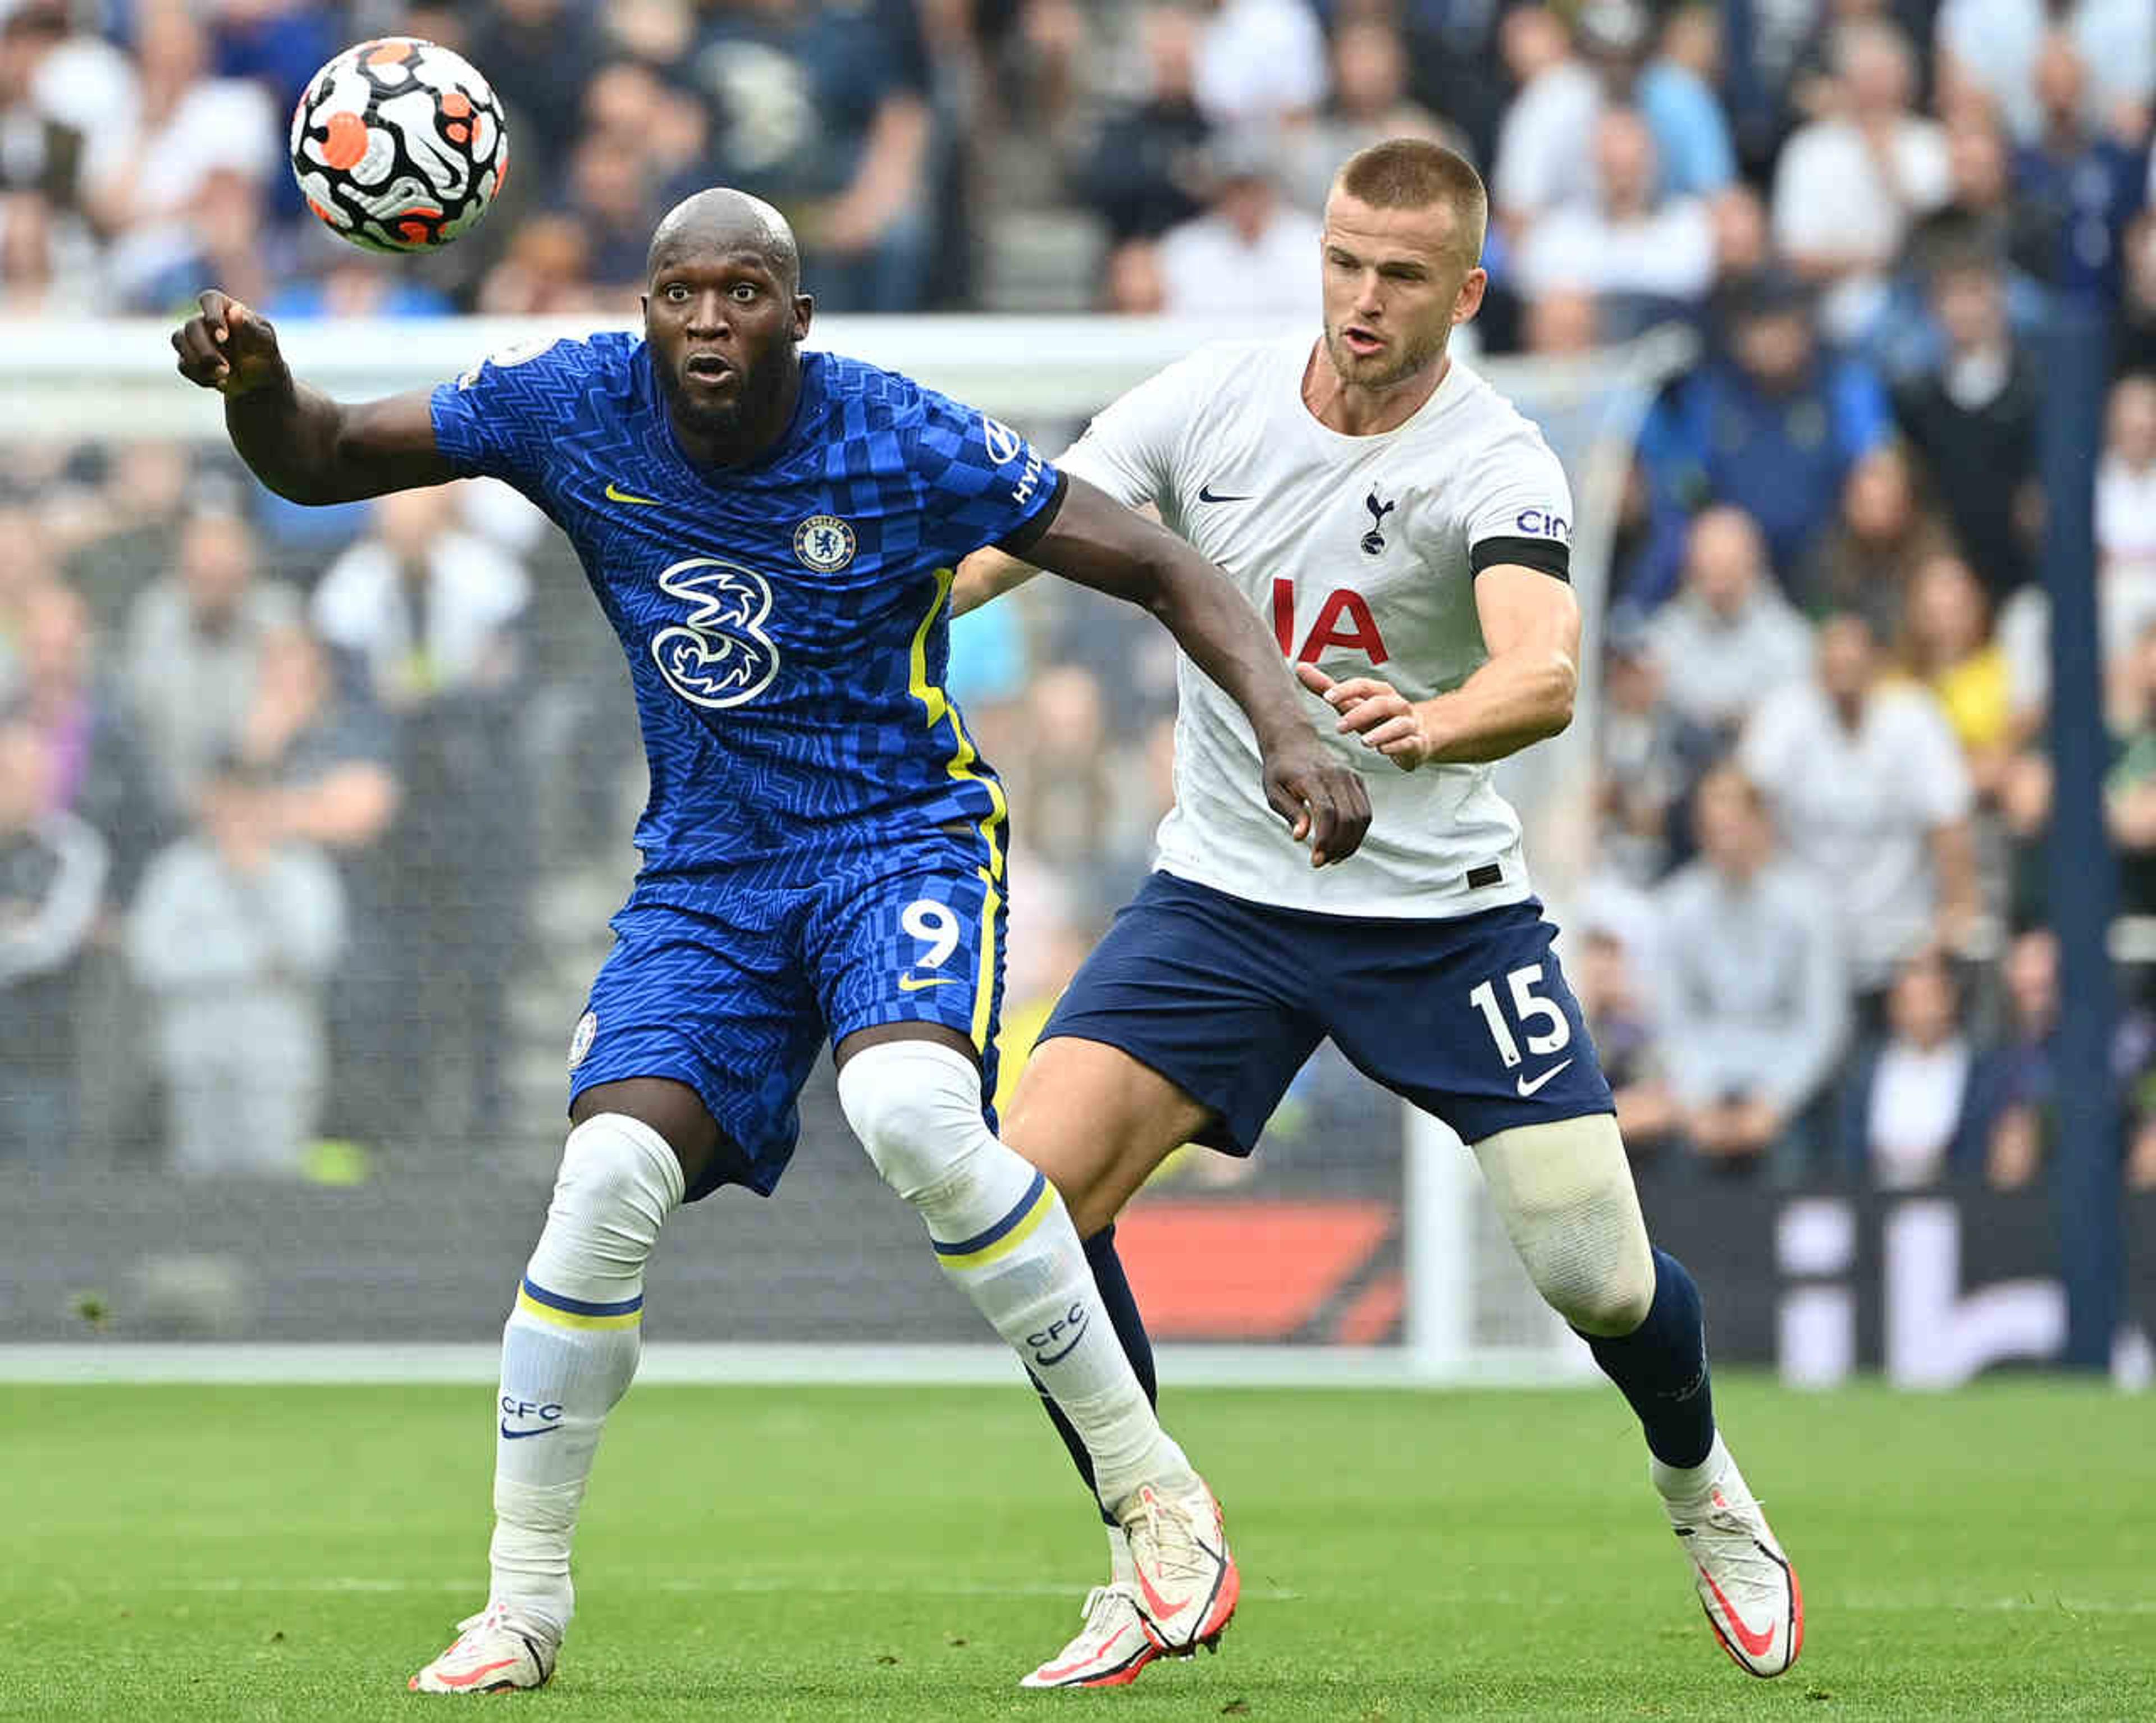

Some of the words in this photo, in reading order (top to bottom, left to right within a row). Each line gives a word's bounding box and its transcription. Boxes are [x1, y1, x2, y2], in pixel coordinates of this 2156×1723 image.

[652, 557, 780, 708] 3
[902, 899, 959, 968] 9
[1470, 964, 1570, 1068] 15
[1026, 1302, 1084, 1347] CFC
[501, 1396, 563, 1420] CFC
